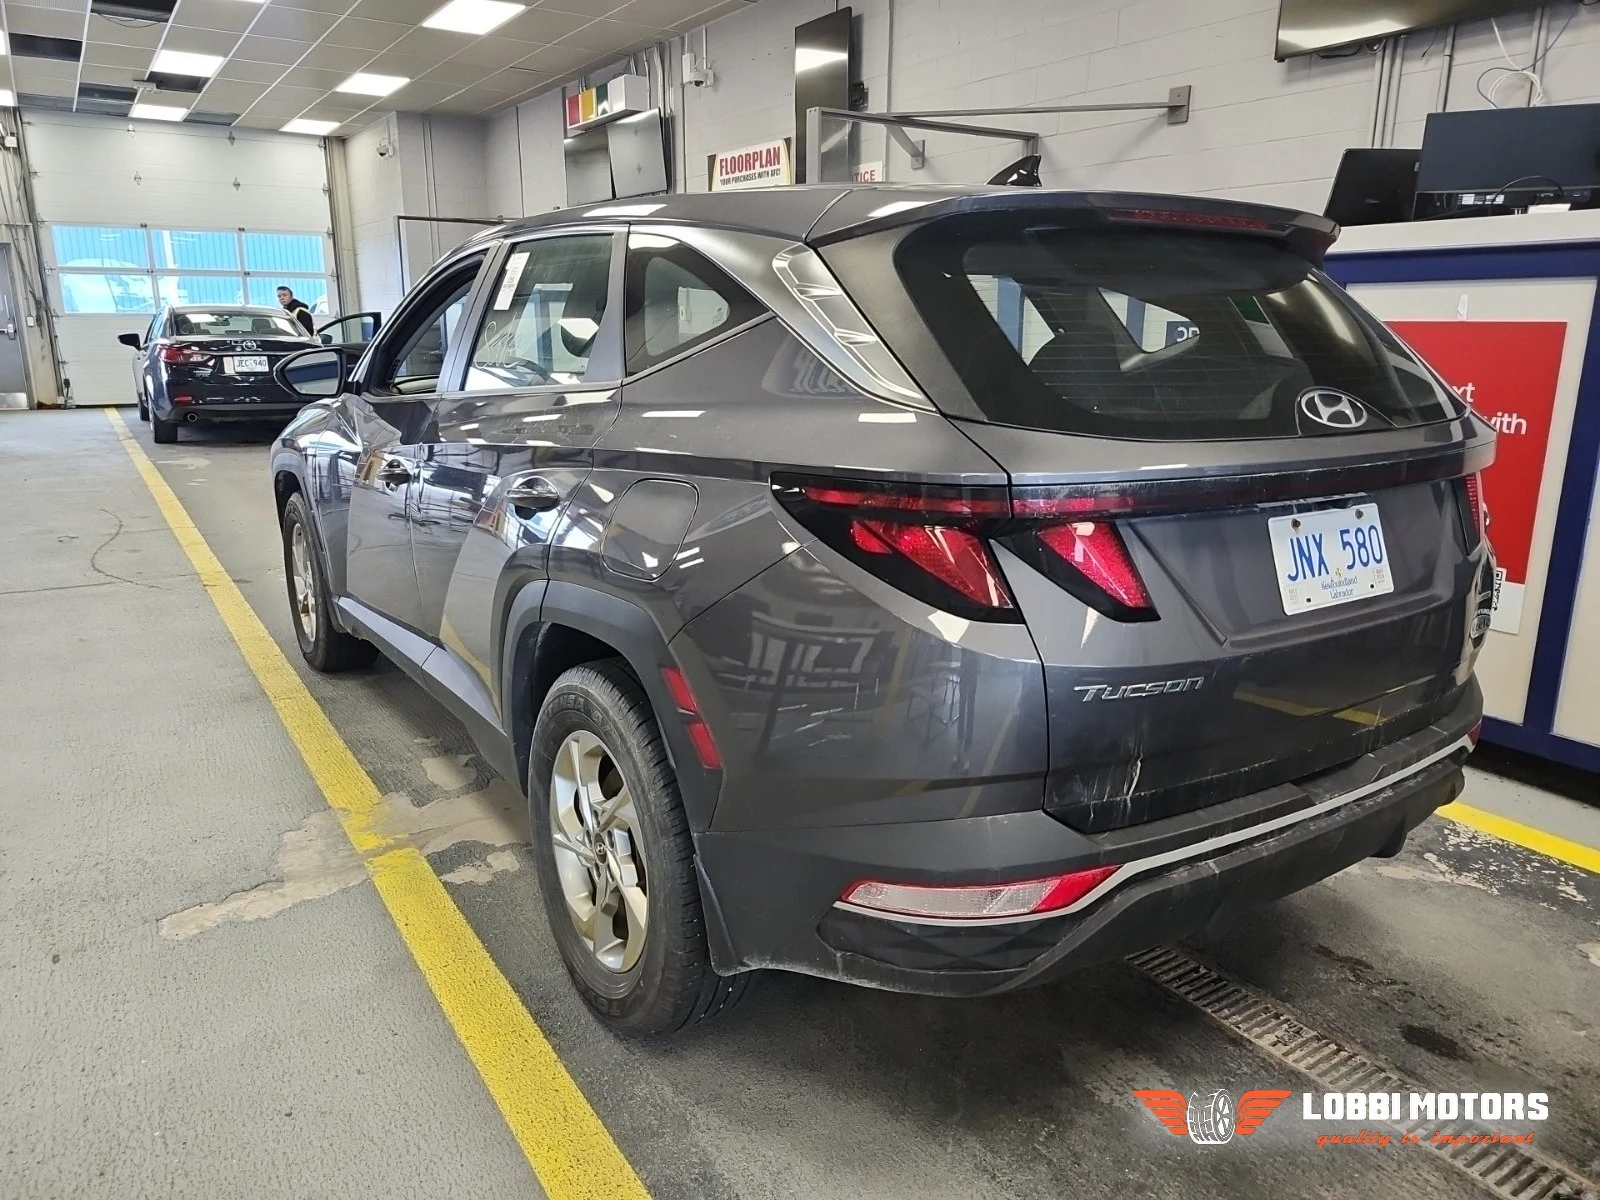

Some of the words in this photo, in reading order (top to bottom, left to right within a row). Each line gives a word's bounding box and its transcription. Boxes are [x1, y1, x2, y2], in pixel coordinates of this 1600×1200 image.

[719, 145, 781, 177] FLOORPLAN
[719, 177, 731, 187] YOUR
[731, 172, 757, 184] PURCHASES
[757, 169, 770, 180] WITH
[851, 169, 876, 183] TICE
[236, 359, 250, 368] JEC
[253, 359, 267, 368] 940
[1484, 411, 1527, 435] ith
[1287, 532, 1330, 582] JNX
[1339, 524, 1384, 571] 580
[1320, 575, 1359, 591] Newfoundland
[1329, 587, 1355, 600] Labrador
